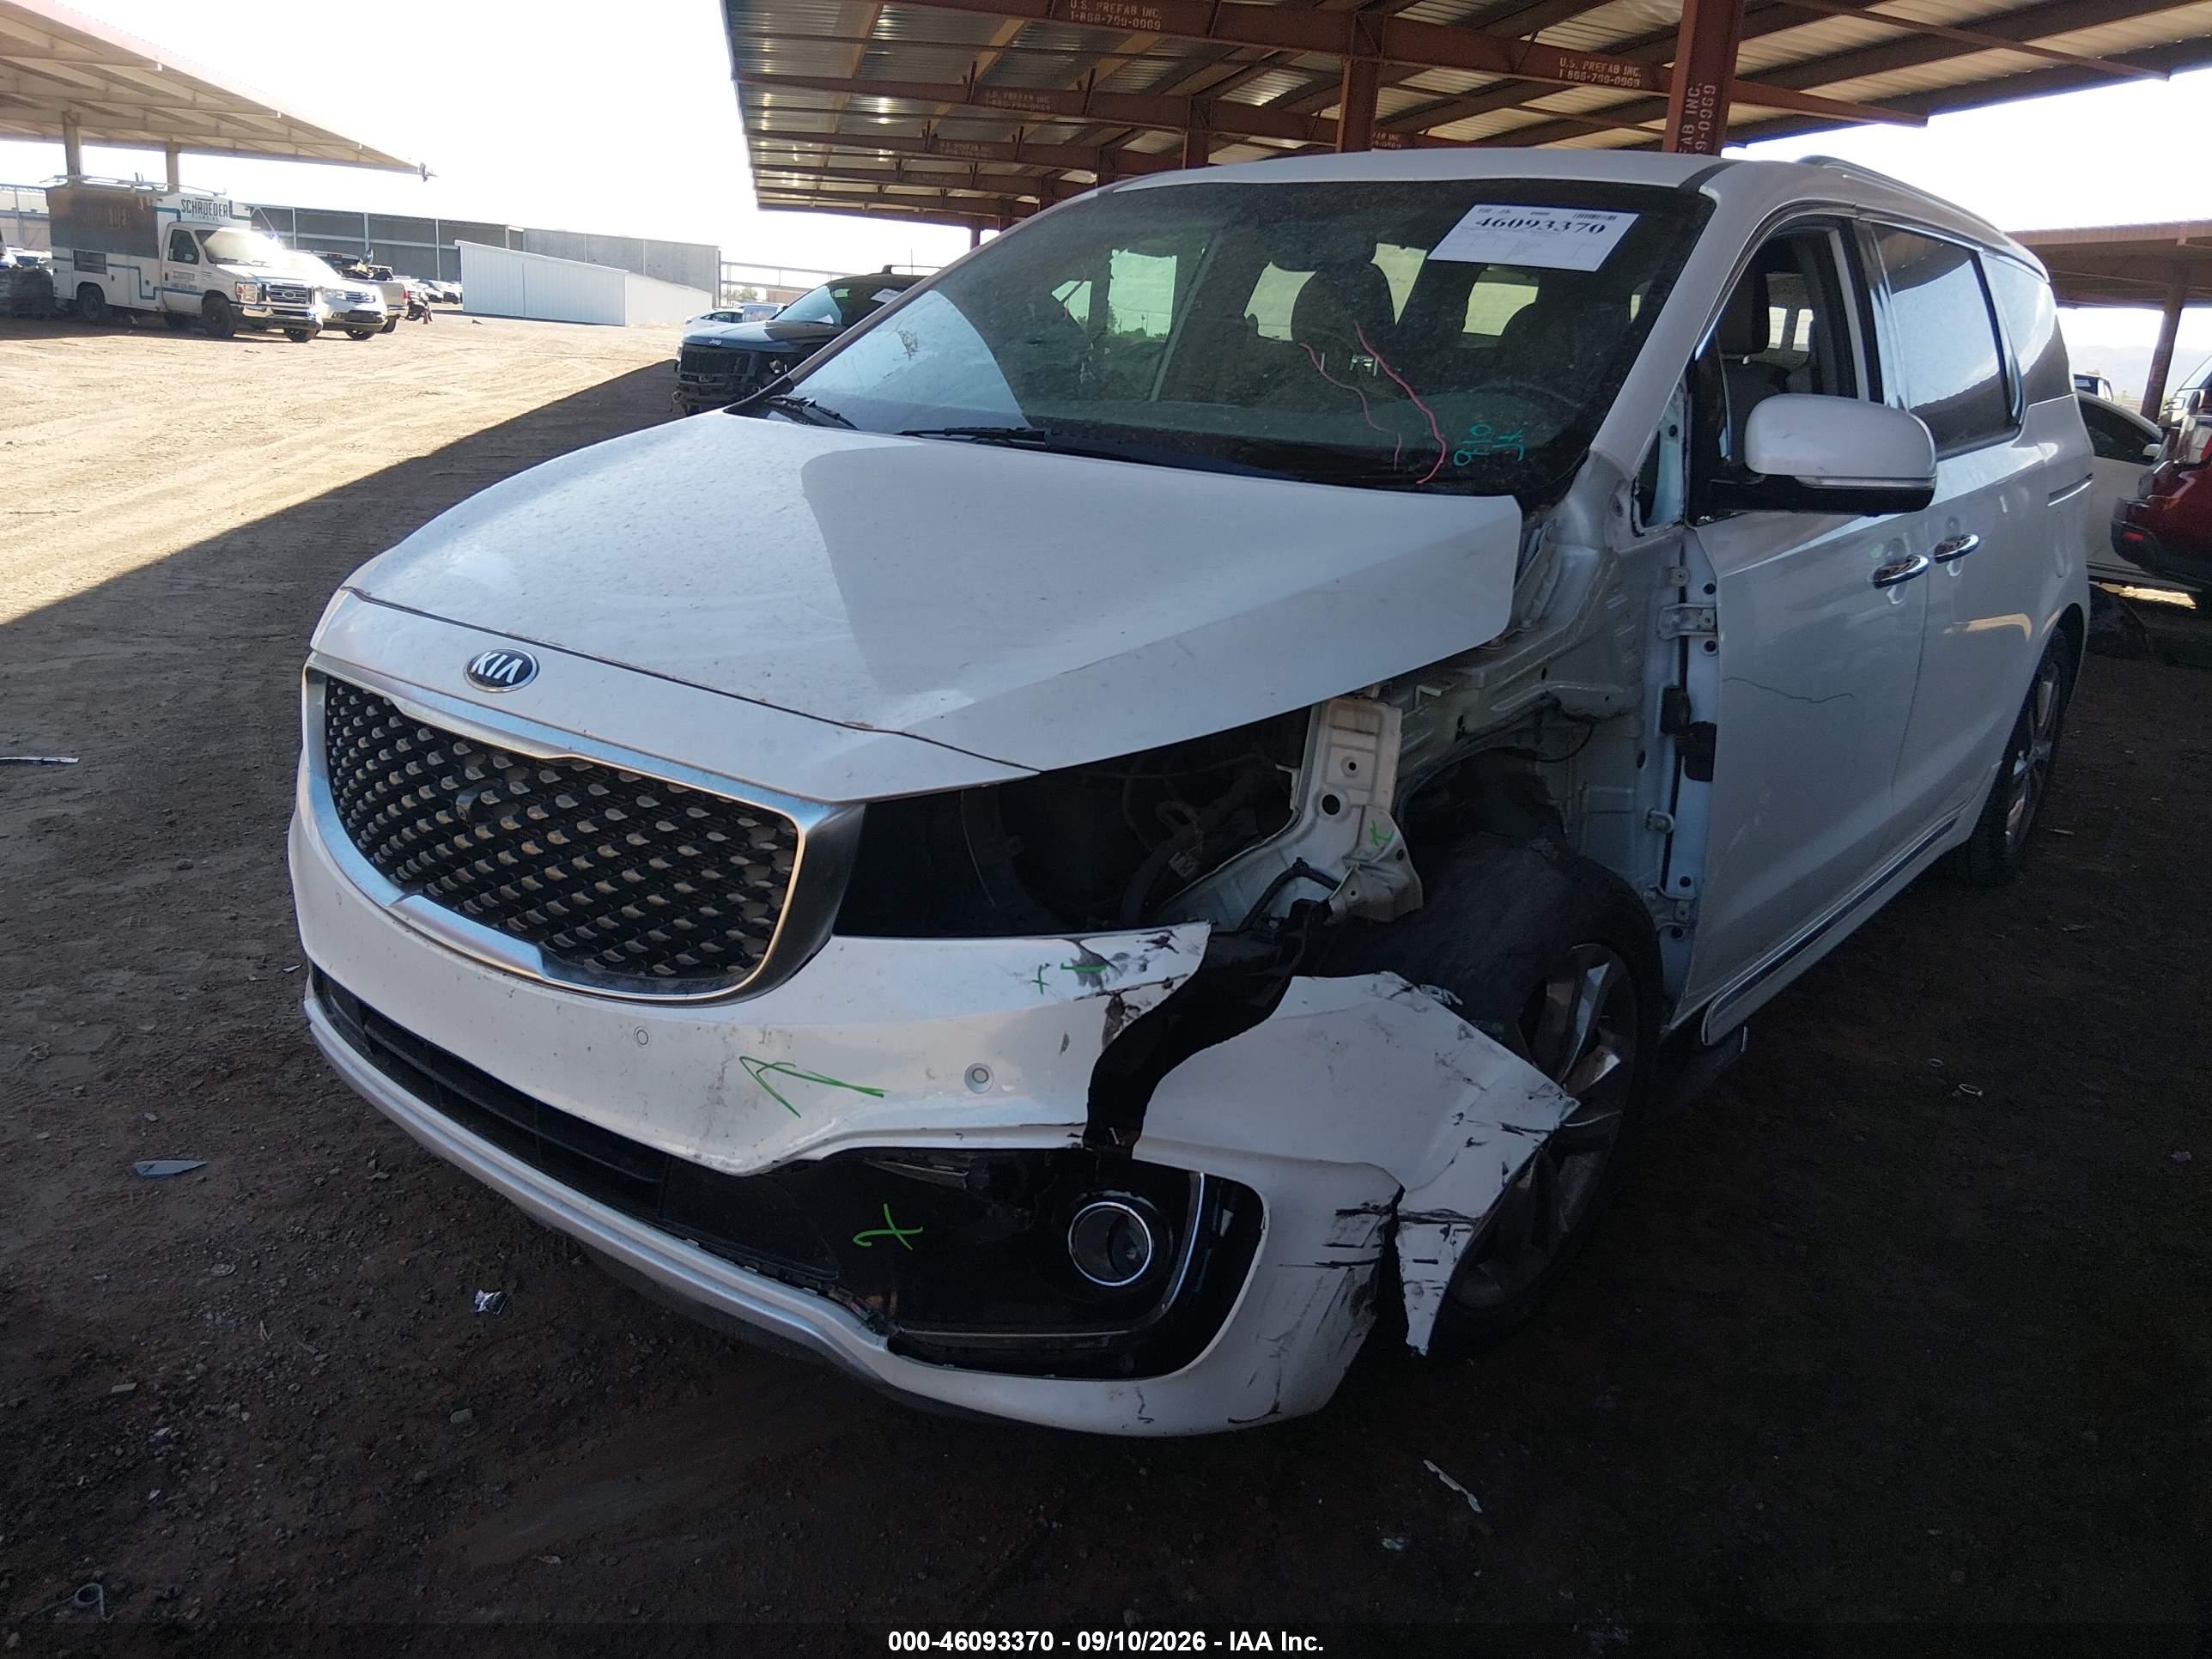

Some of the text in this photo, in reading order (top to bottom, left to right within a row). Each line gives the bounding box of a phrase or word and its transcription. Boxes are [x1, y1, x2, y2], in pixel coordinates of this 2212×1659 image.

[1096, 2, 1138, 15] PREFAB
[1582, 61, 1620, 76] PREFAB
[1622, 65, 1642, 78] INC.
[1684, 82, 1703, 114] INC.
[180, 198, 228, 218] SCHROEDER
[1475, 216, 1606, 235] 46093370
[470, 652, 524, 684] KIA
